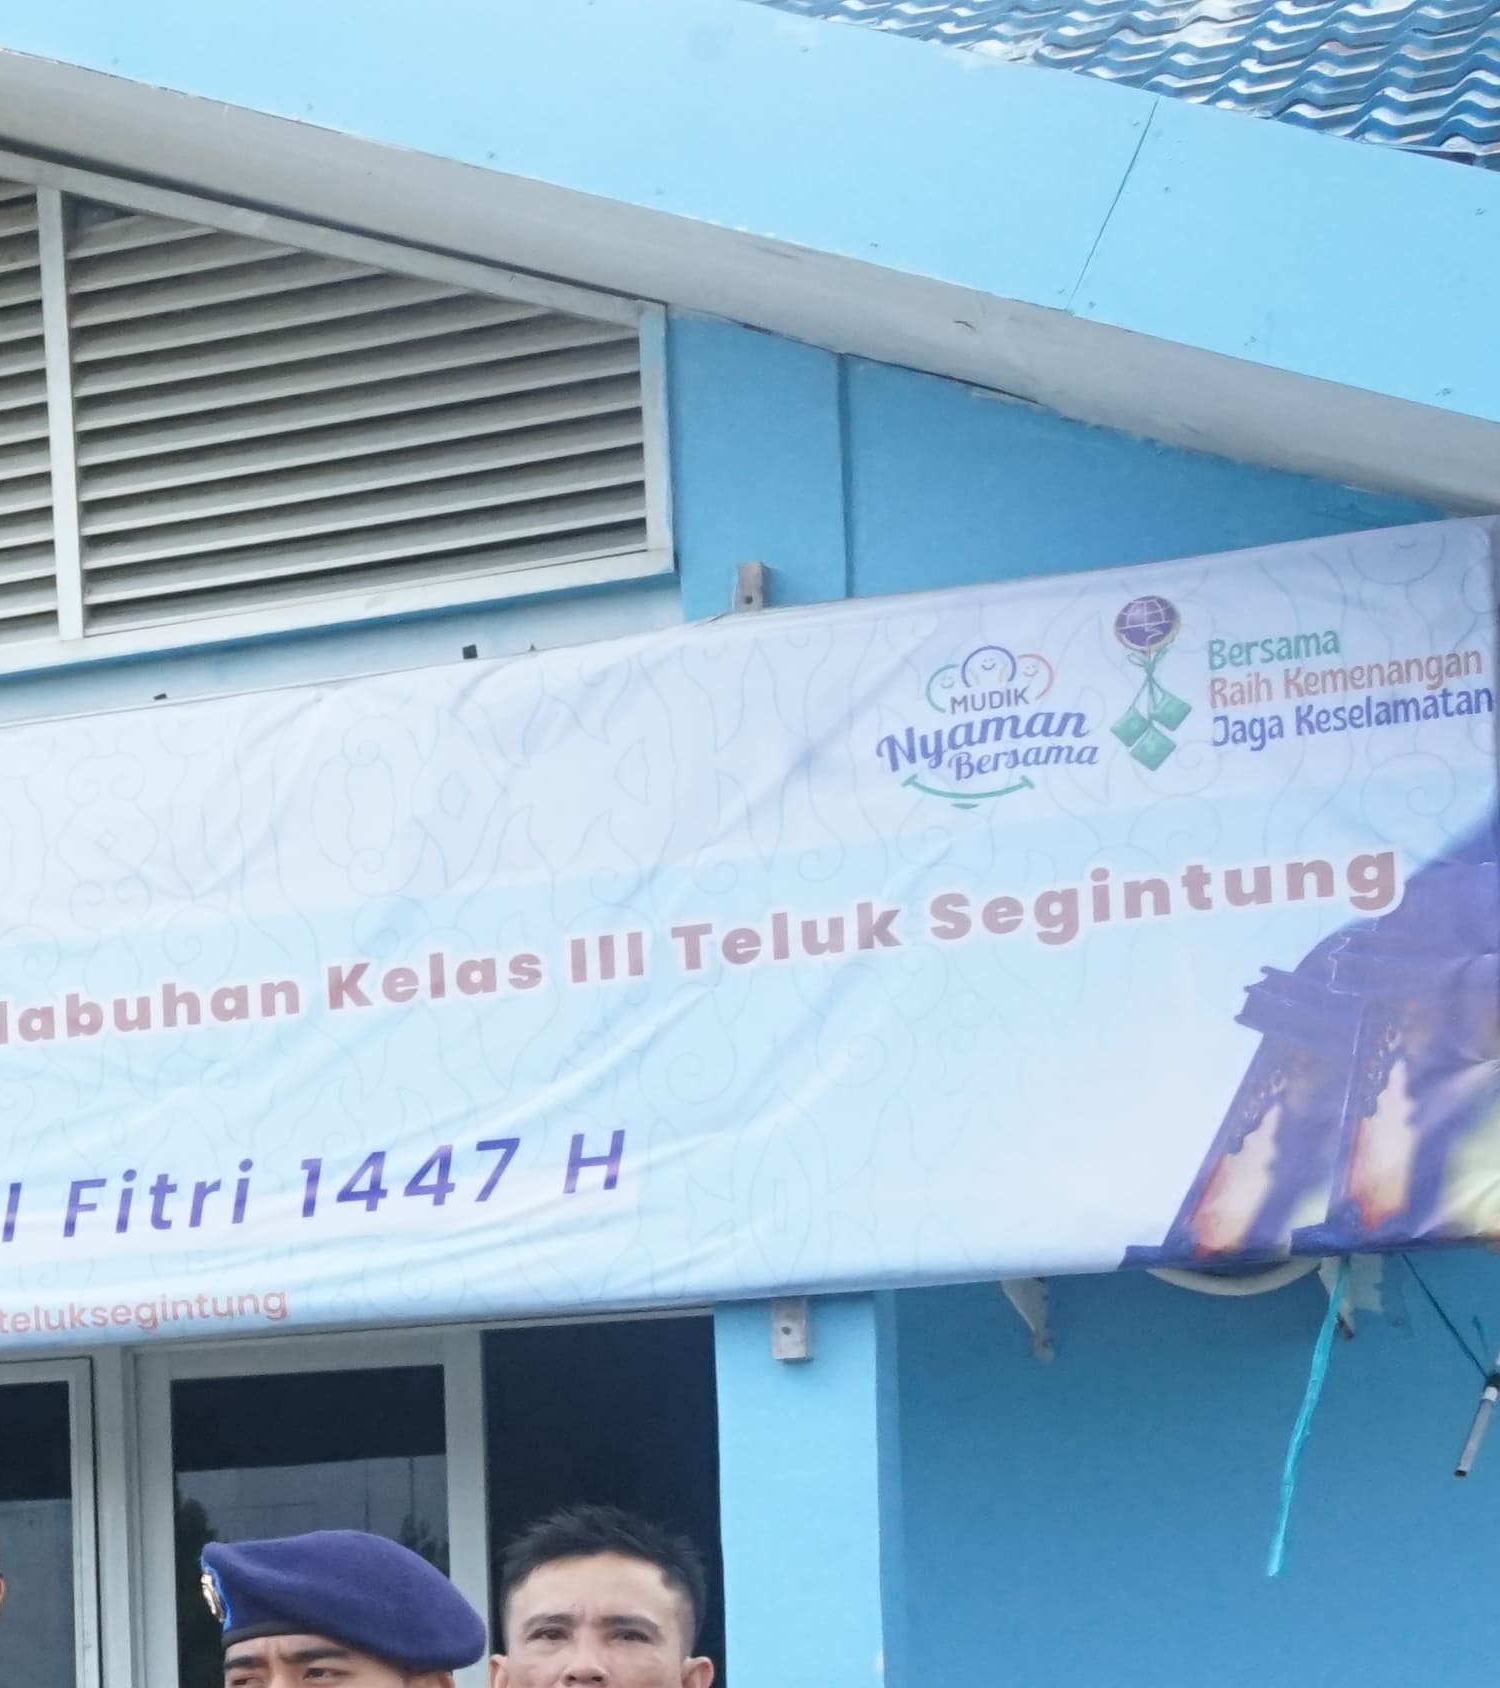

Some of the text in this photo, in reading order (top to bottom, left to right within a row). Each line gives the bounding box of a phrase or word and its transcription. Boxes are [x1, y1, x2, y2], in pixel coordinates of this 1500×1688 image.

[1207, 630, 1341, 671] Bersama
[1209, 650, 1483, 709] Raih Kemenangan
[950, 686, 1030, 715] MUDIK
[1212, 687, 1493, 752] Jaga Keselamatan
[876, 711, 1090, 773] Nyaman
[948, 745, 1100, 781] Bersama
[326, 952, 543, 1010] Kelas
[569, 931, 645, 983] III
[671, 900, 902, 972] Teluk
[929, 850, 1396, 946] Segintung
[62, 1157, 255, 1239] Fitri
[300, 1136, 522, 1219] 1447
[562, 1129, 626, 1195] H
